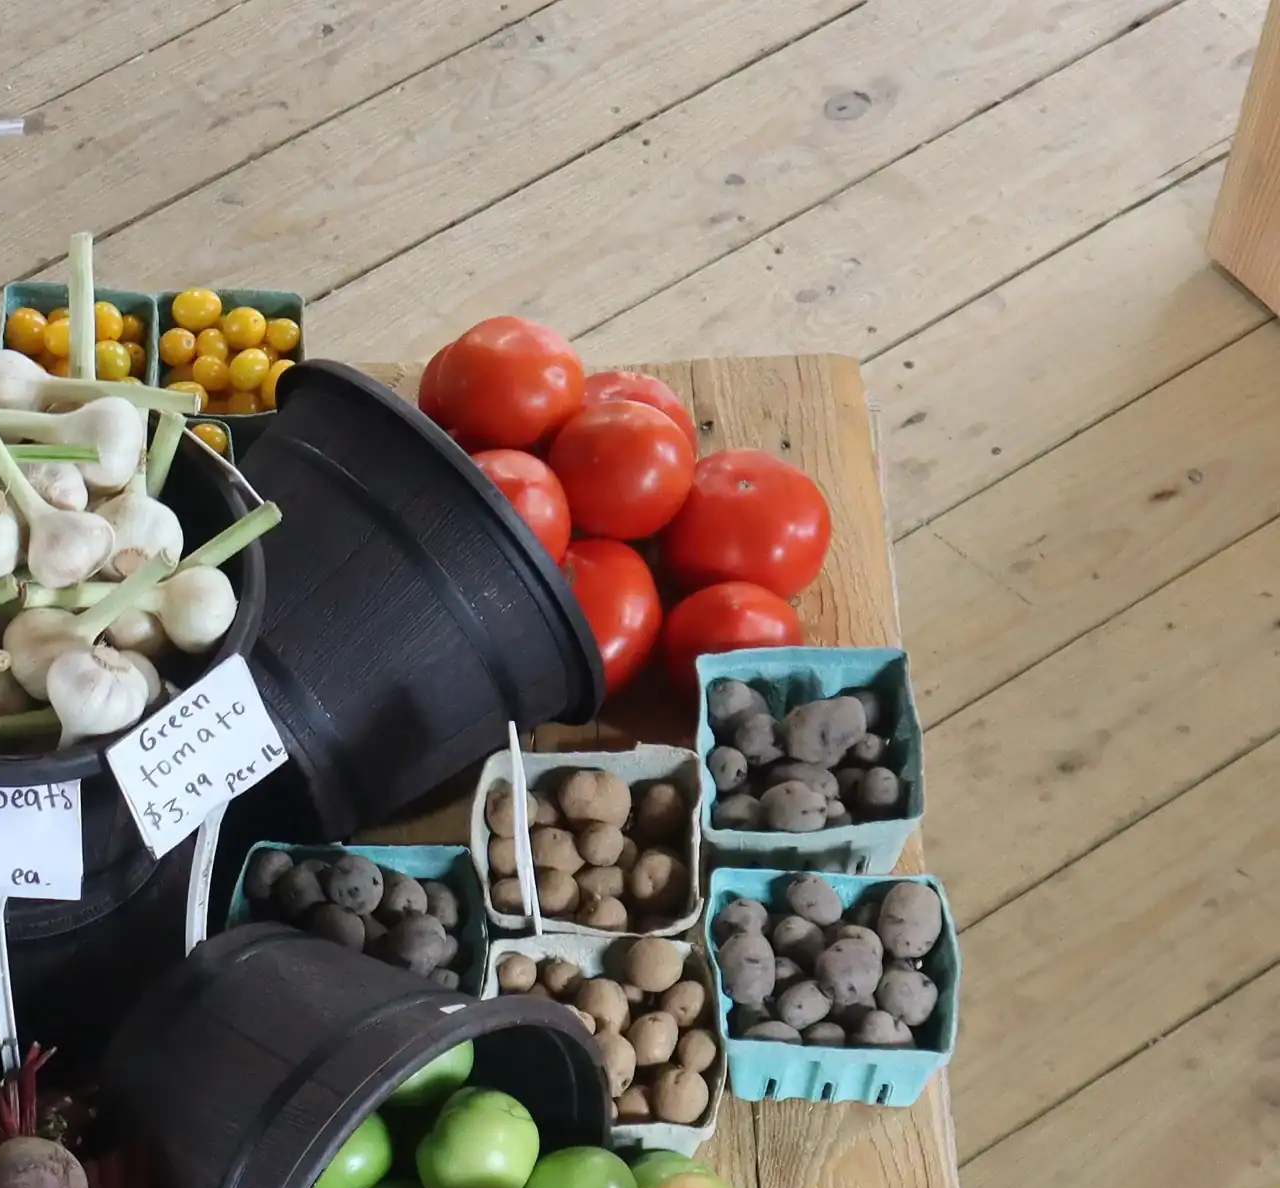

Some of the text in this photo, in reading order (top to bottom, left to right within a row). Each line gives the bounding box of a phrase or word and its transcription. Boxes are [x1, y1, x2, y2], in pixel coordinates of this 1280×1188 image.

[139, 692, 210, 752] Green
[139, 701, 246, 788] tomato
[224, 760, 257, 795] per
[11, 868, 51, 886] ea.
